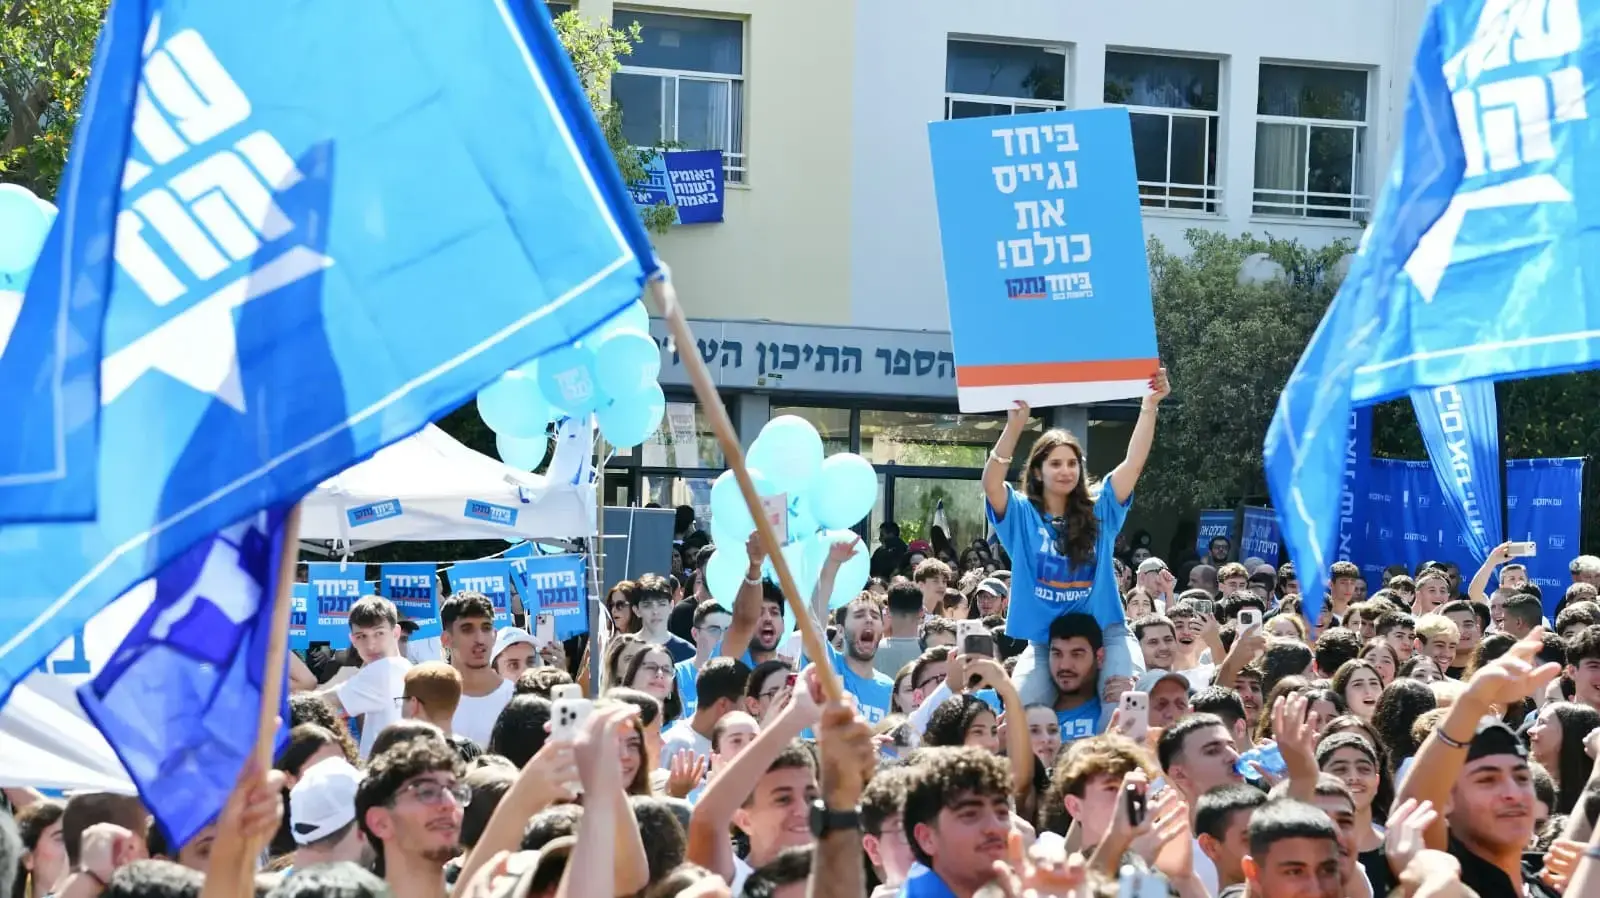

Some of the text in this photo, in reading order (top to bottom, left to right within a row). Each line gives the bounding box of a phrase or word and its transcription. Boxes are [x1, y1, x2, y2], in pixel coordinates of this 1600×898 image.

[992, 123, 1079, 157] ביחד
[669, 168, 715, 183] האומץ
[992, 160, 1078, 194] נגייס
[673, 180, 716, 194] לשנות
[676, 192, 719, 207] באמת
[1014, 198, 1067, 230] את
[996, 231, 1092, 269] כולם!
[1005, 272, 1092, 298] ביחד נתקן
[755, 341, 862, 375] התיכון
[312, 579, 360, 597] ביחד
[385, 574, 431, 588] ביחד
[460, 575, 505, 592] ביחד
[531, 570, 577, 589] ביחד
[389, 587, 431, 602] נתקן
[537, 586, 578, 608] נתקן
[317, 596, 359, 615] תקן
